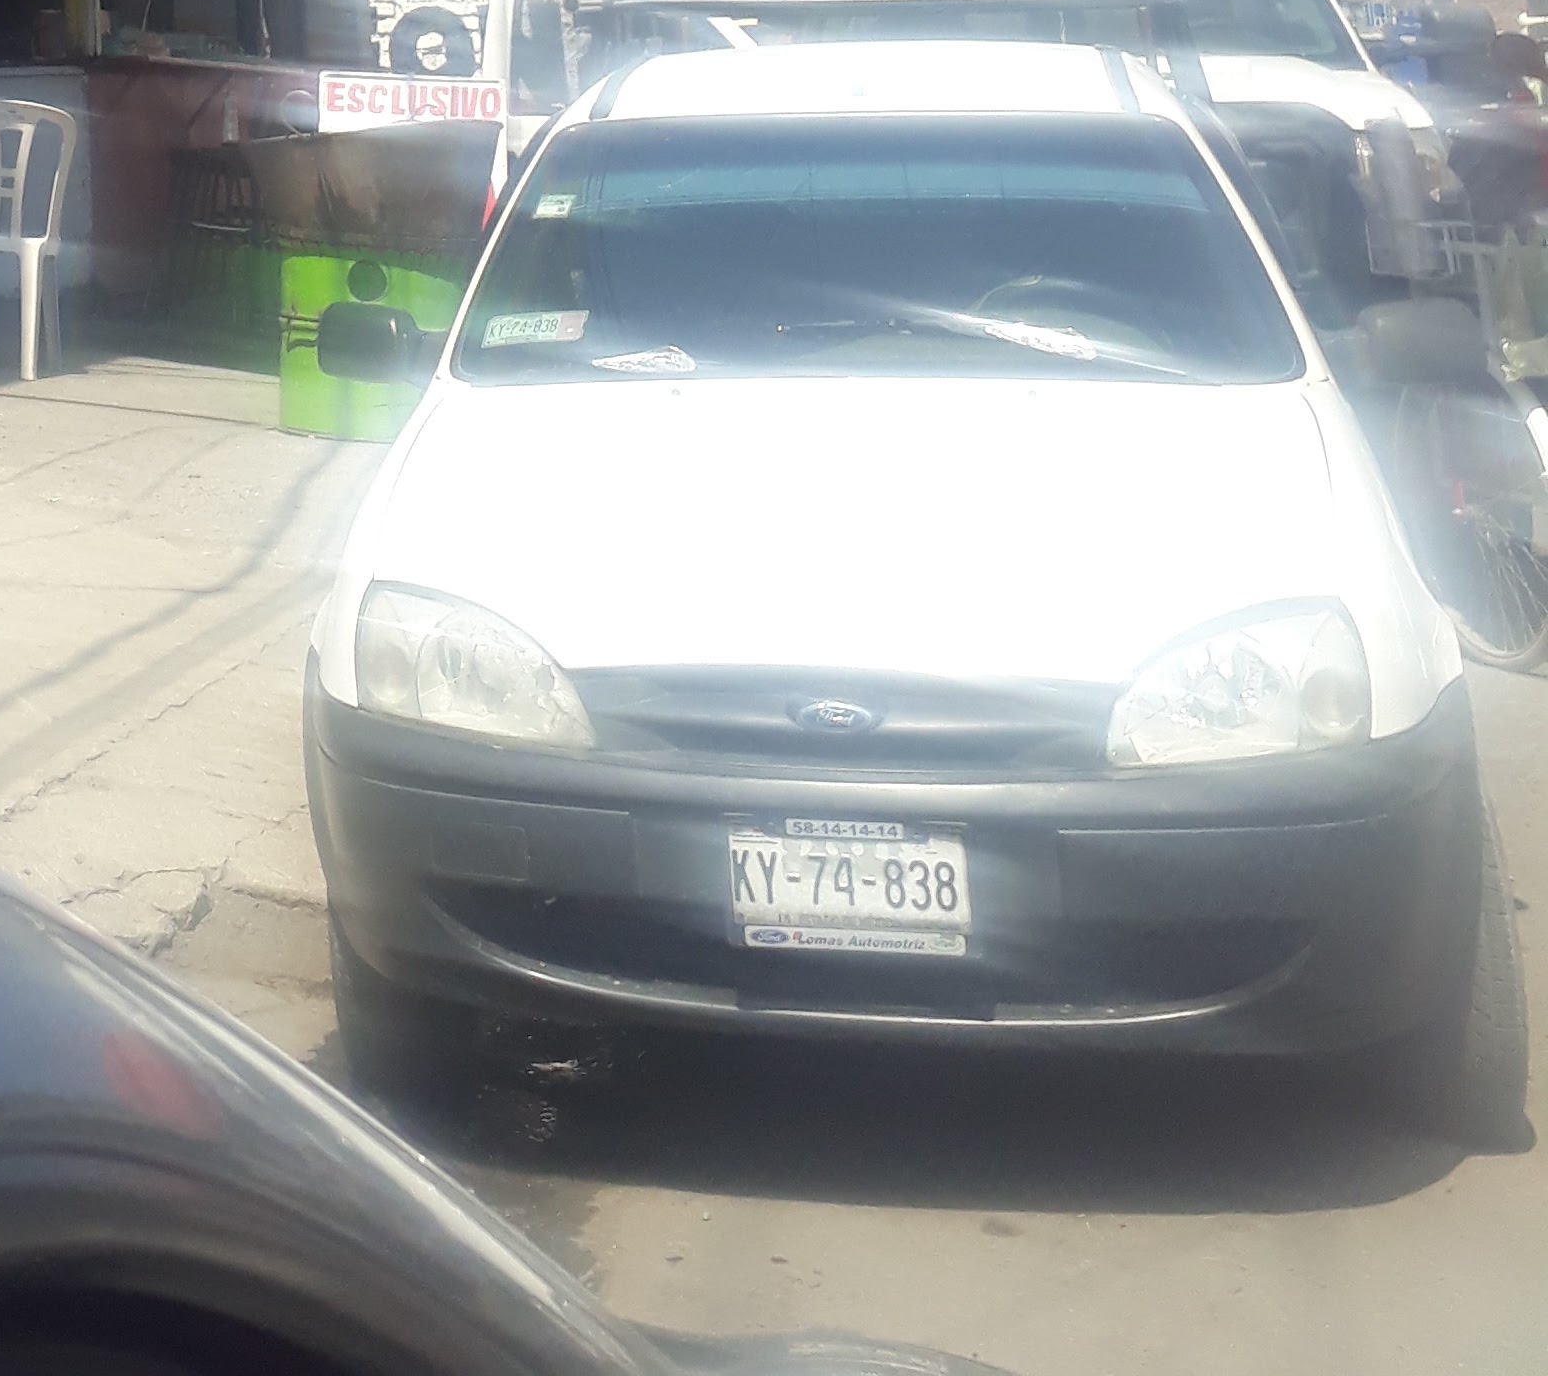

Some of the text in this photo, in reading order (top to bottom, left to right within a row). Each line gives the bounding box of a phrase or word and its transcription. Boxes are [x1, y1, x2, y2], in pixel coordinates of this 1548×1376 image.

[326, 81, 501, 119] ESCLUSIVO
[793, 821, 898, 838] 58-14-14-14
[731, 849, 958, 912] KY-74-838
